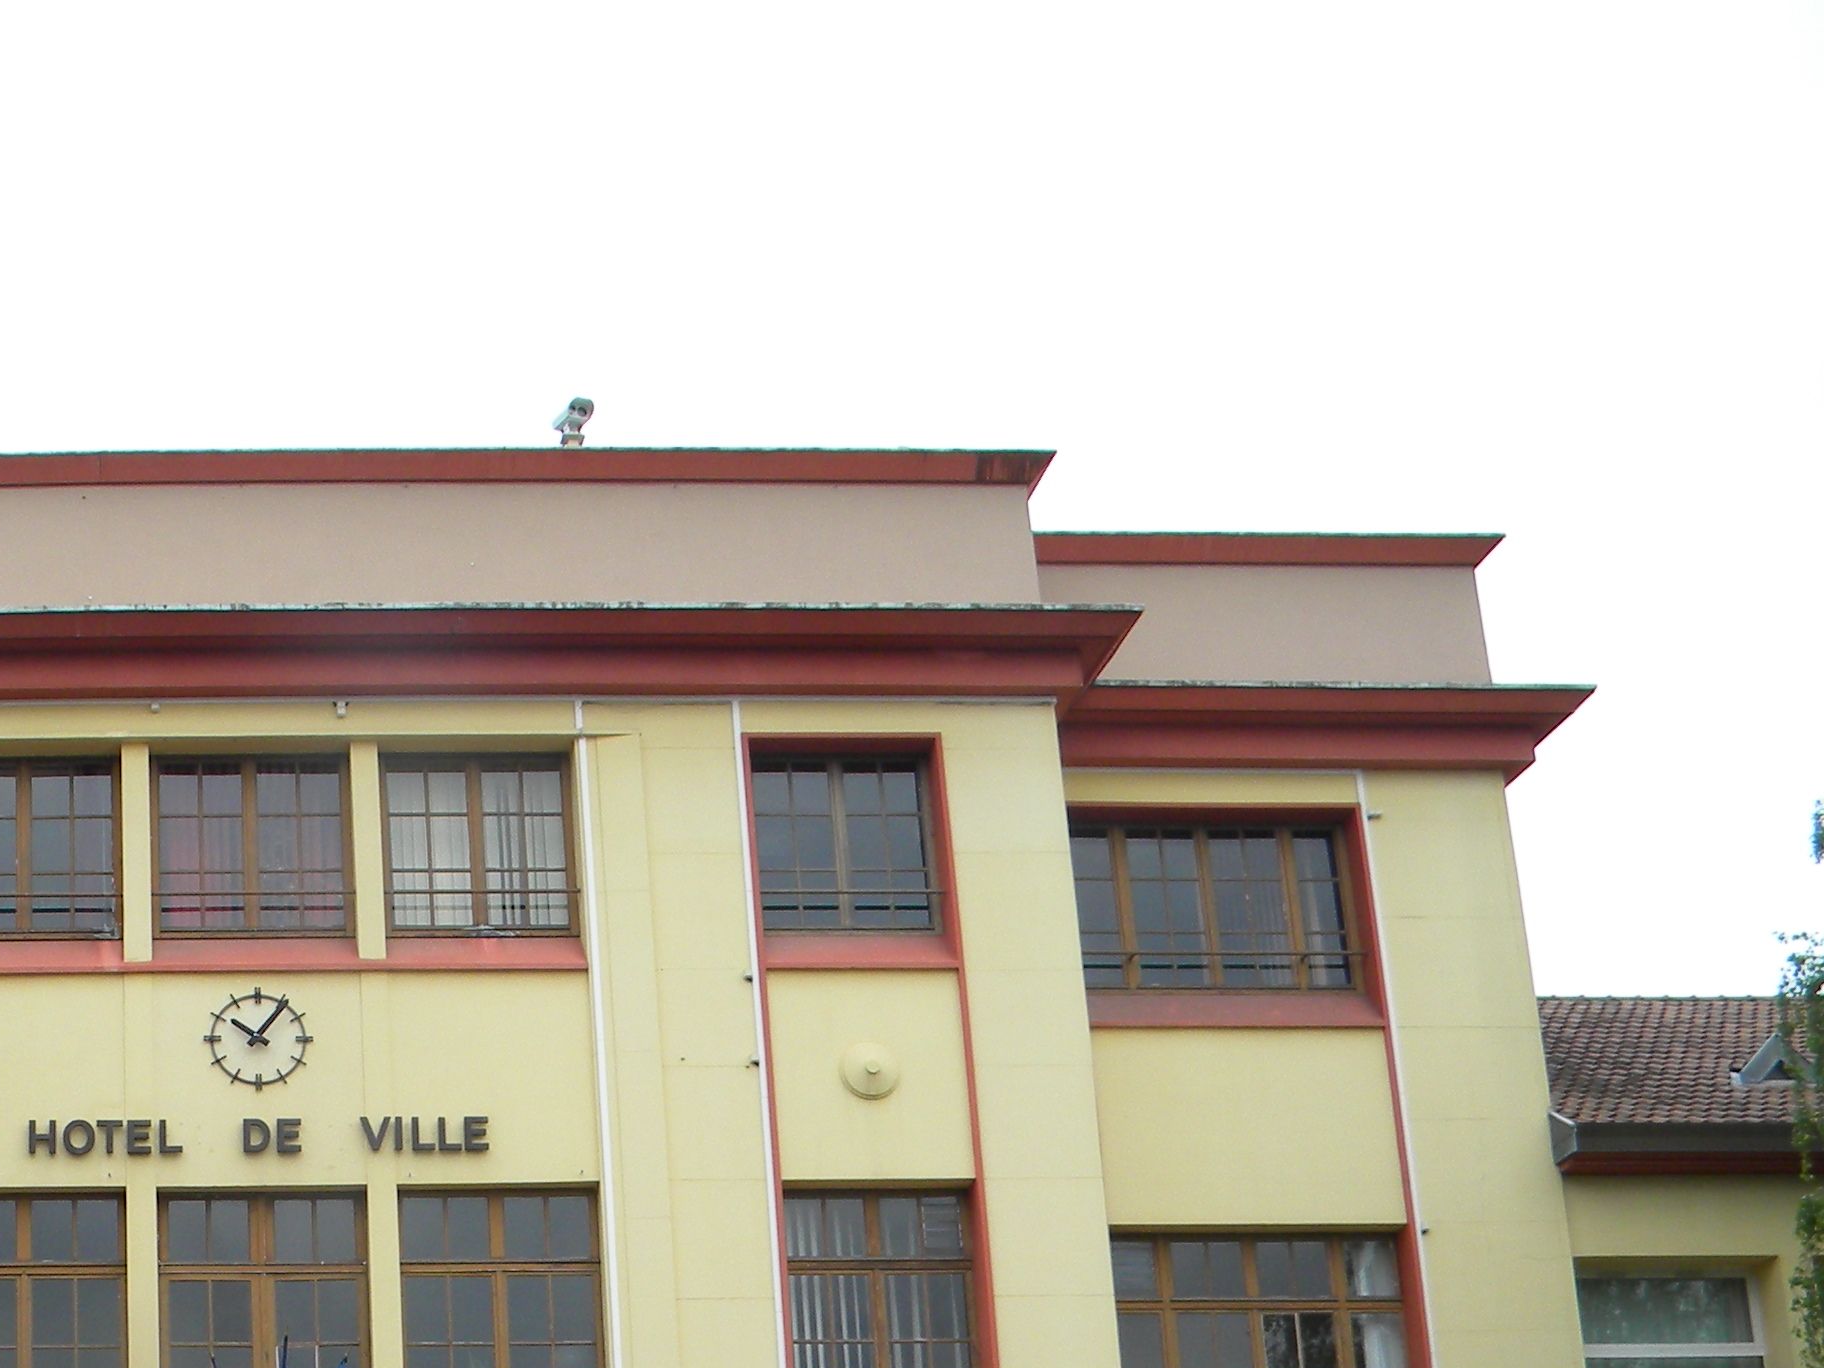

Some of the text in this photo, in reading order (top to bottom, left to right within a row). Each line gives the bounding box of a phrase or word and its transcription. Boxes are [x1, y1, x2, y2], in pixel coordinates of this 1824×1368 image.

[27, 1115, 490, 1156] HOTEL DE VILLE
